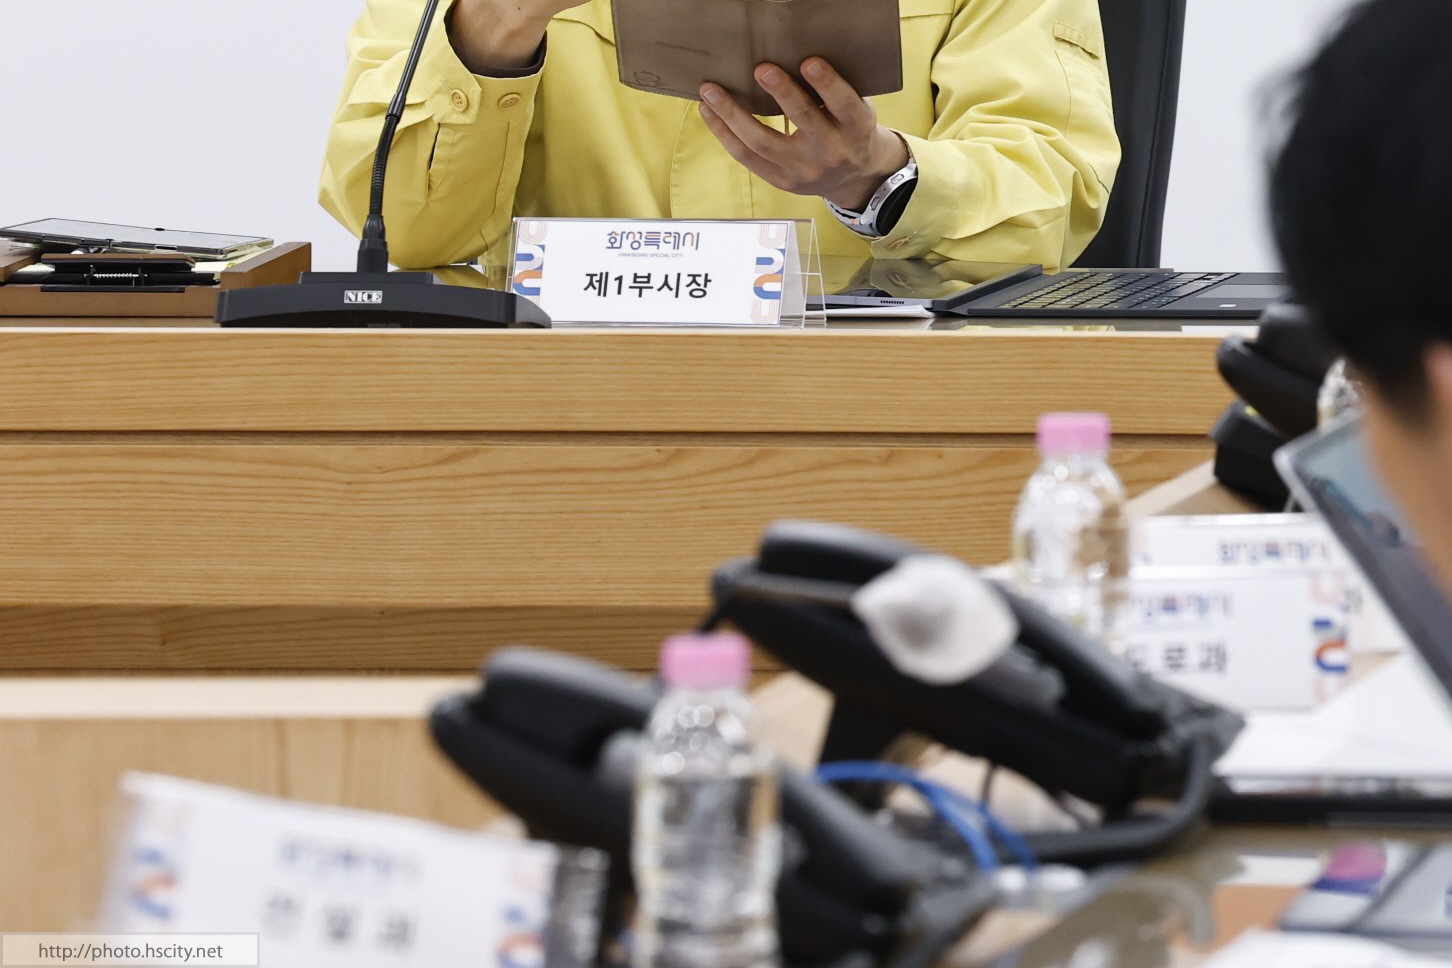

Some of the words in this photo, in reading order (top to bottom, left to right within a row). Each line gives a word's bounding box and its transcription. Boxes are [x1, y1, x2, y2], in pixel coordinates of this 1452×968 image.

[605, 231, 700, 251] 화성특례시
[583, 271, 712, 299] 제1부시장
[345, 291, 382, 302] NICE
